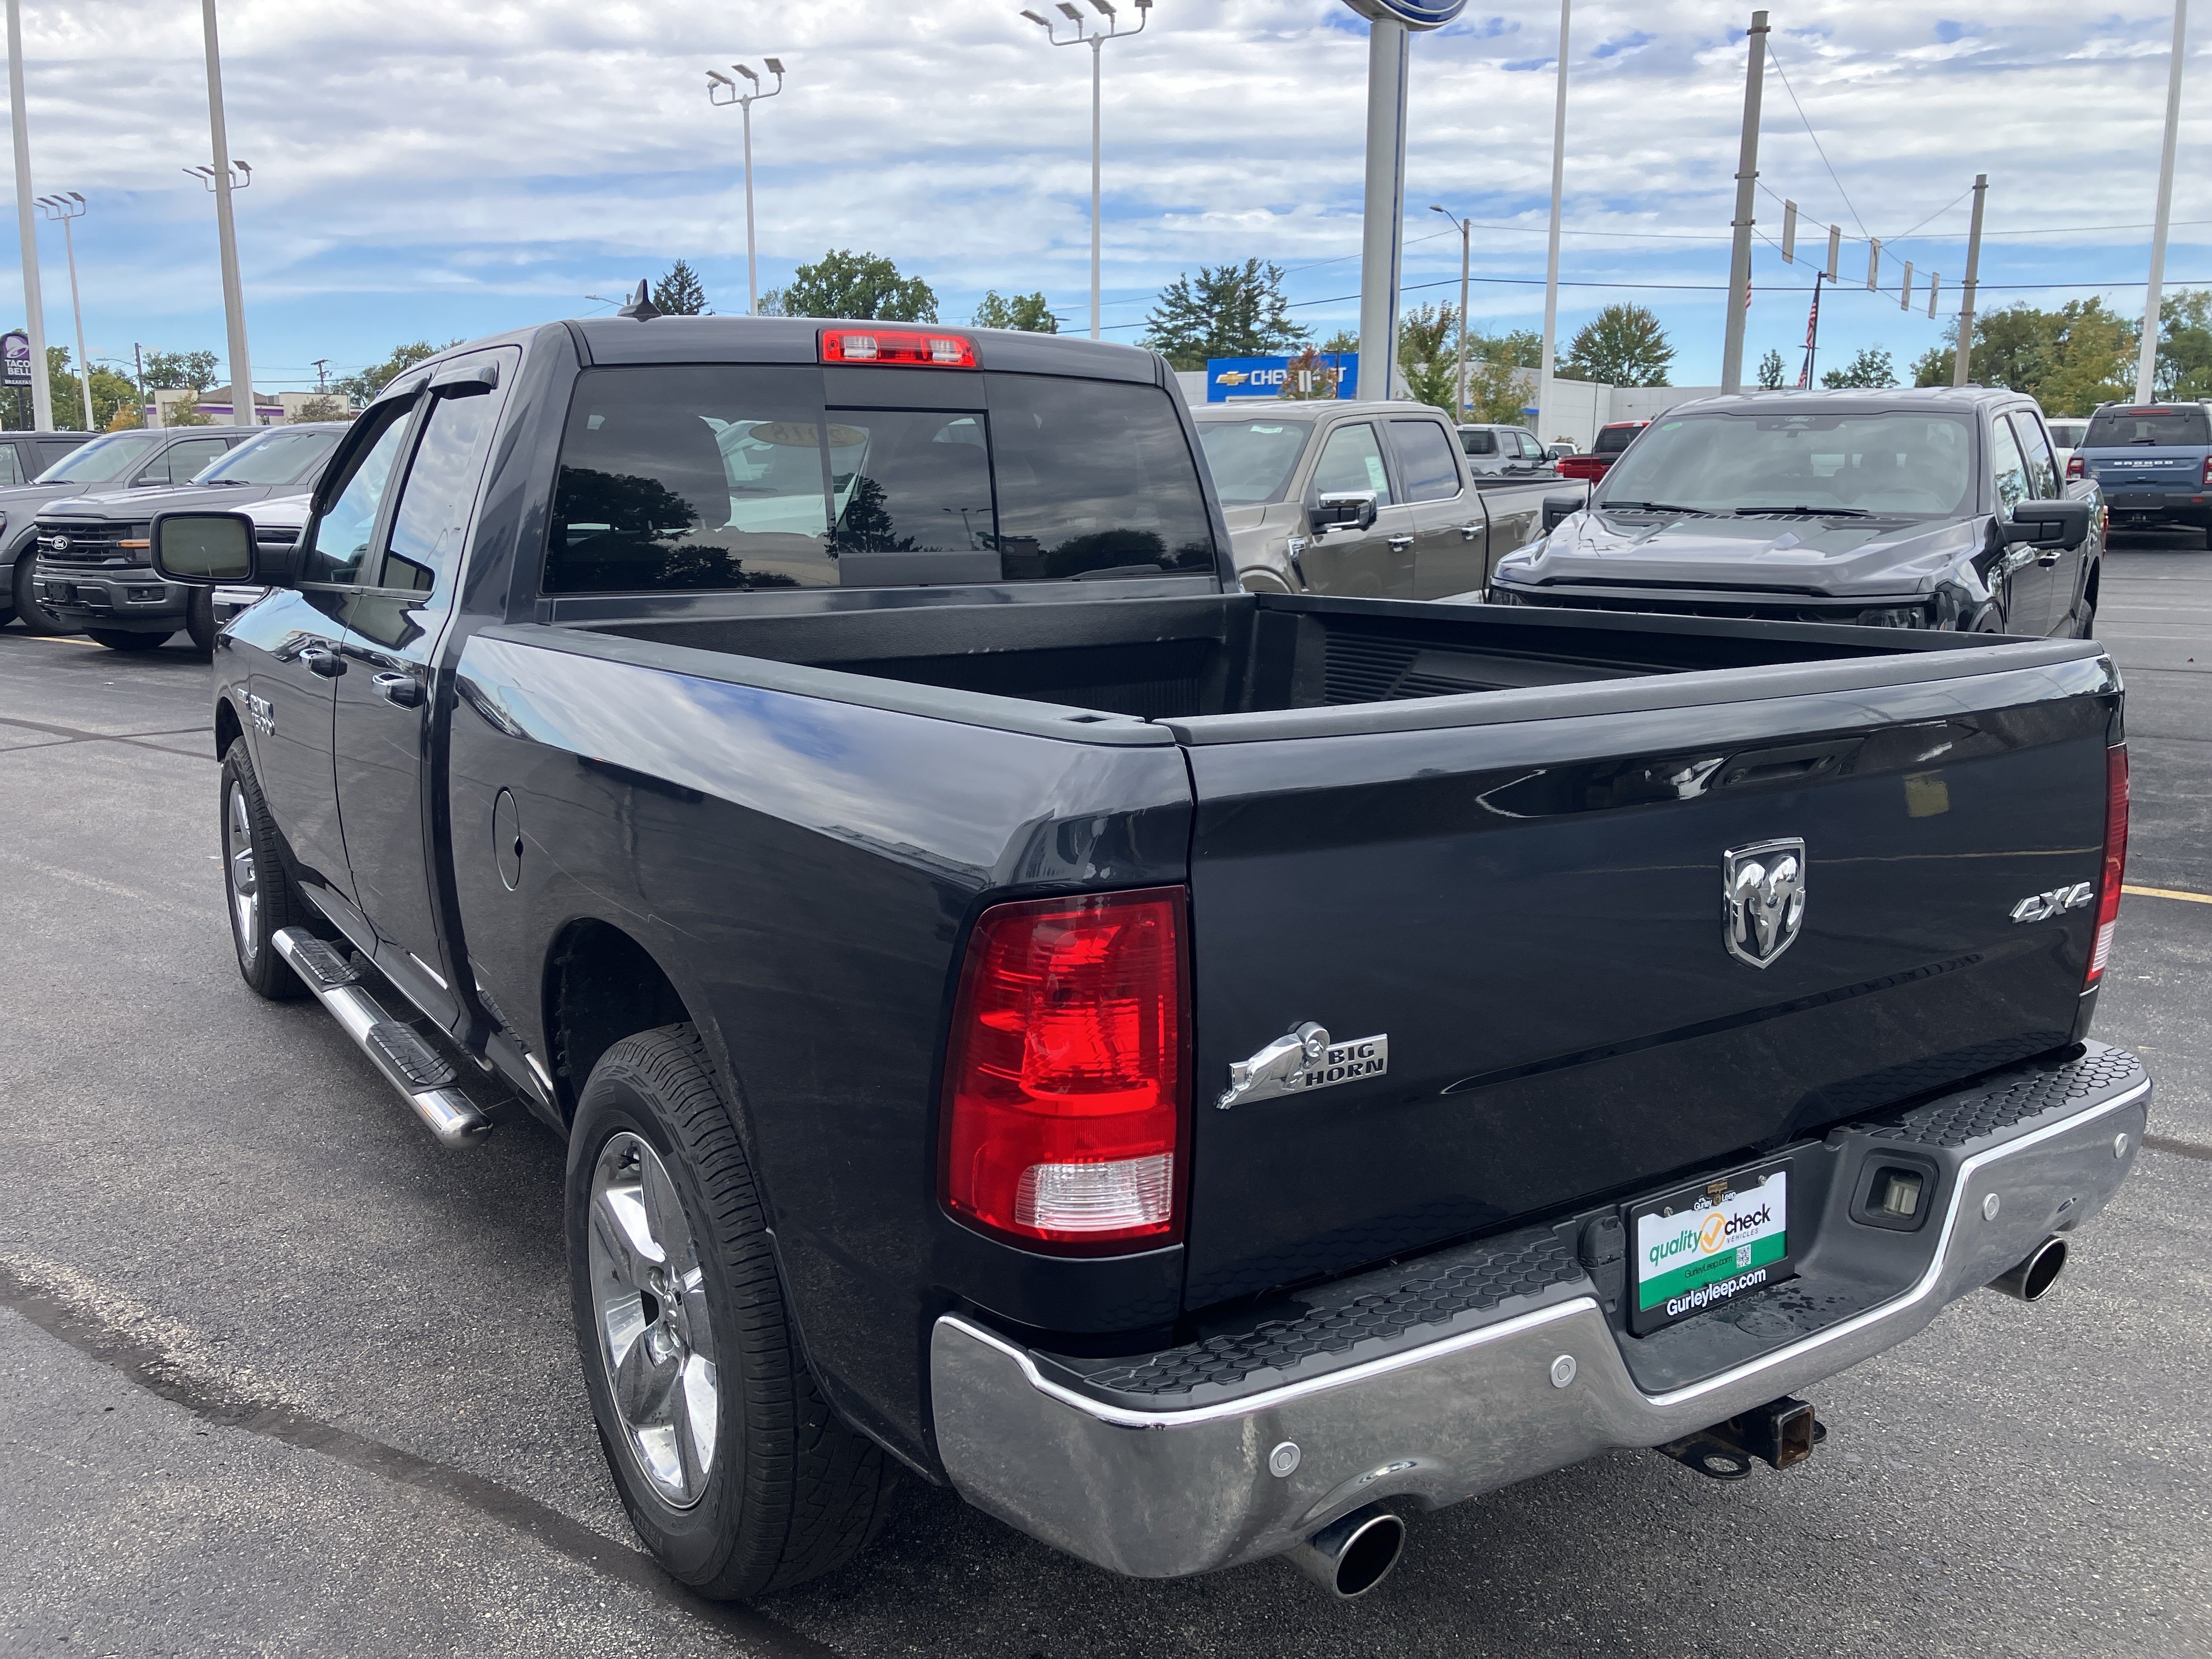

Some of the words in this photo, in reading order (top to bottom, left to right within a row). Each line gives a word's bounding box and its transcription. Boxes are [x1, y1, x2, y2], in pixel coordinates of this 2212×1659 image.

[4, 359, 30, 368] TACO
[8, 367, 31, 375] BELL
[1328, 1043, 1375, 1066] BIG
[1305, 1058, 1384, 1088] HORN
[1694, 1199, 1713, 1211] Gurley
[1722, 1192, 1736, 1201] Leep
[1650, 1229, 1703, 1266] quality
[1724, 1203, 1771, 1235] check
[1726, 1228, 1759, 1244] VEHICLES
[1685, 1256, 1733, 1279] GurleyLeep.com
[1666, 1268, 1767, 1316] Gurleyleep.com
